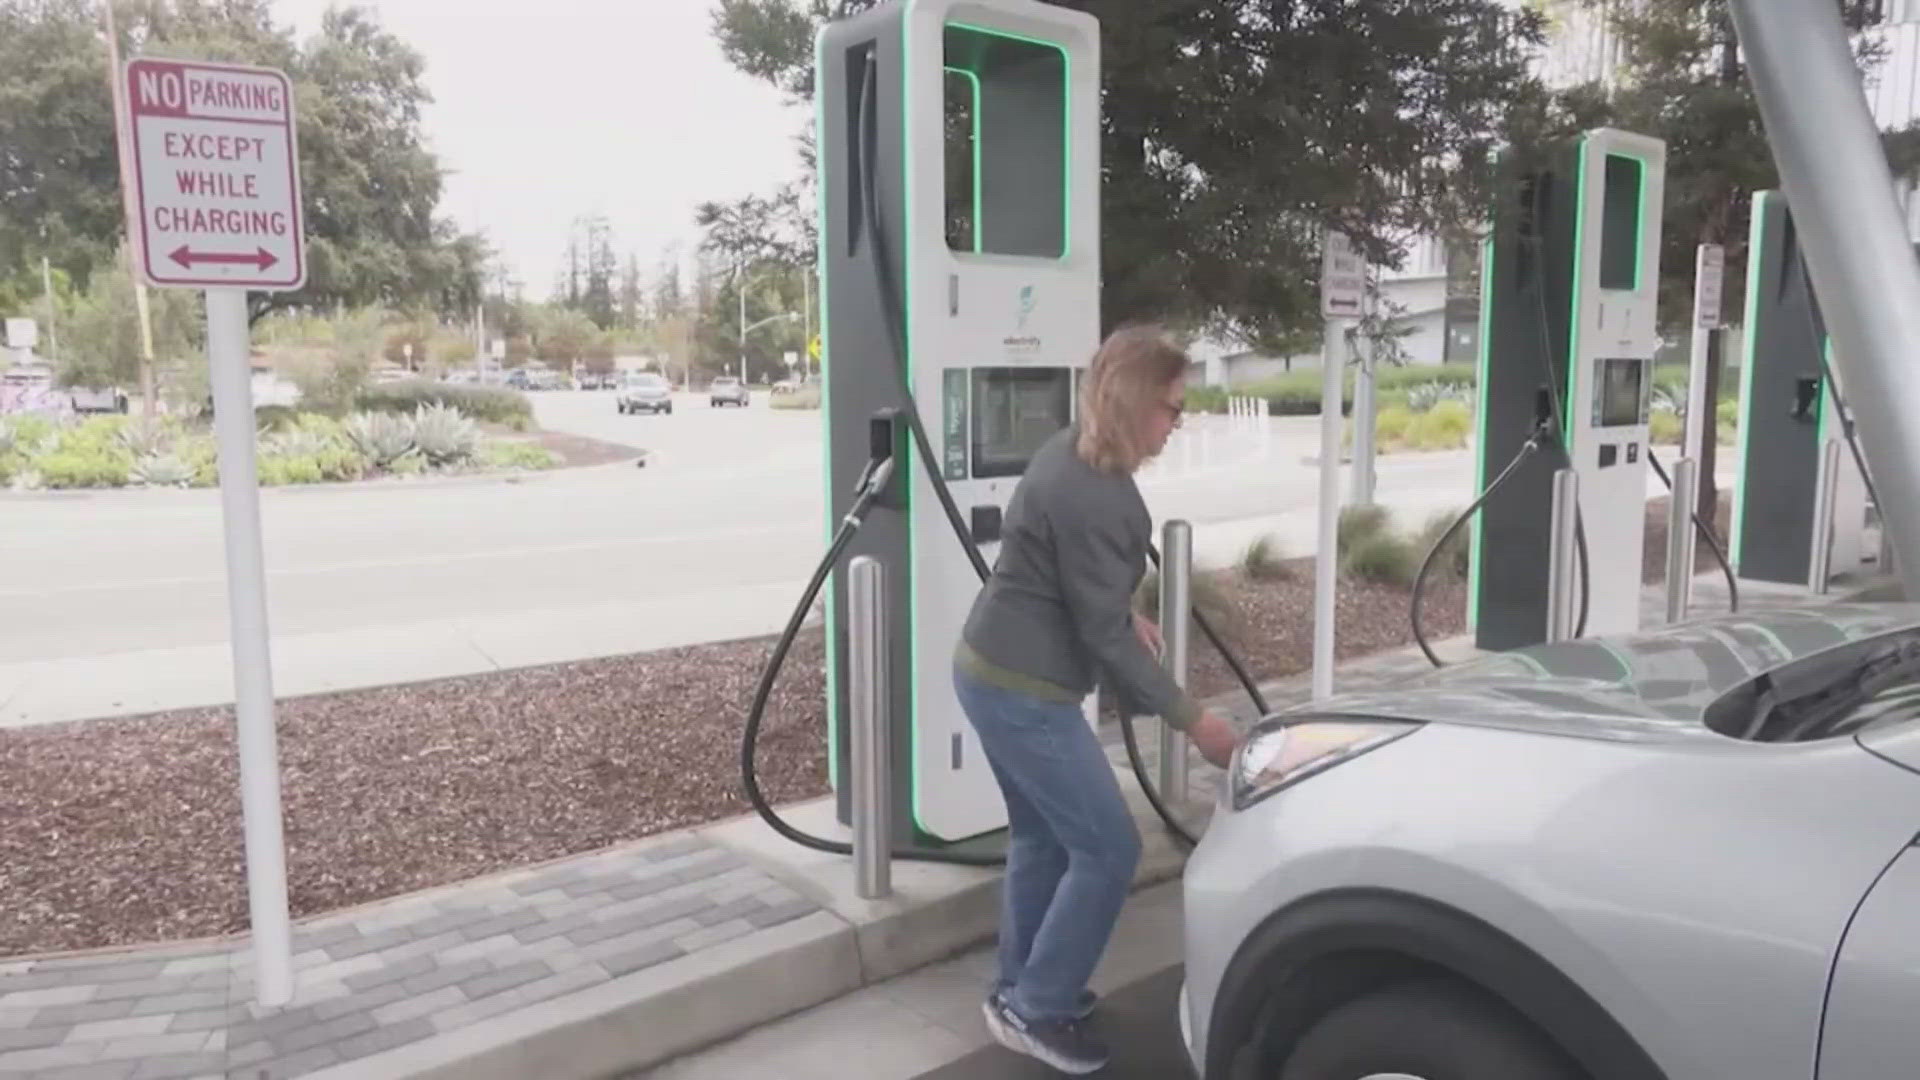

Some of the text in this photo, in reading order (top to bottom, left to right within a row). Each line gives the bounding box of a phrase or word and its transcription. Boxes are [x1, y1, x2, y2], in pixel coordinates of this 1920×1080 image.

[138, 70, 280, 111] NO PARKING
[164, 132, 264, 162] EXCEPT
[176, 169, 258, 198] WHILE
[154, 207, 286, 236] CHARGING
